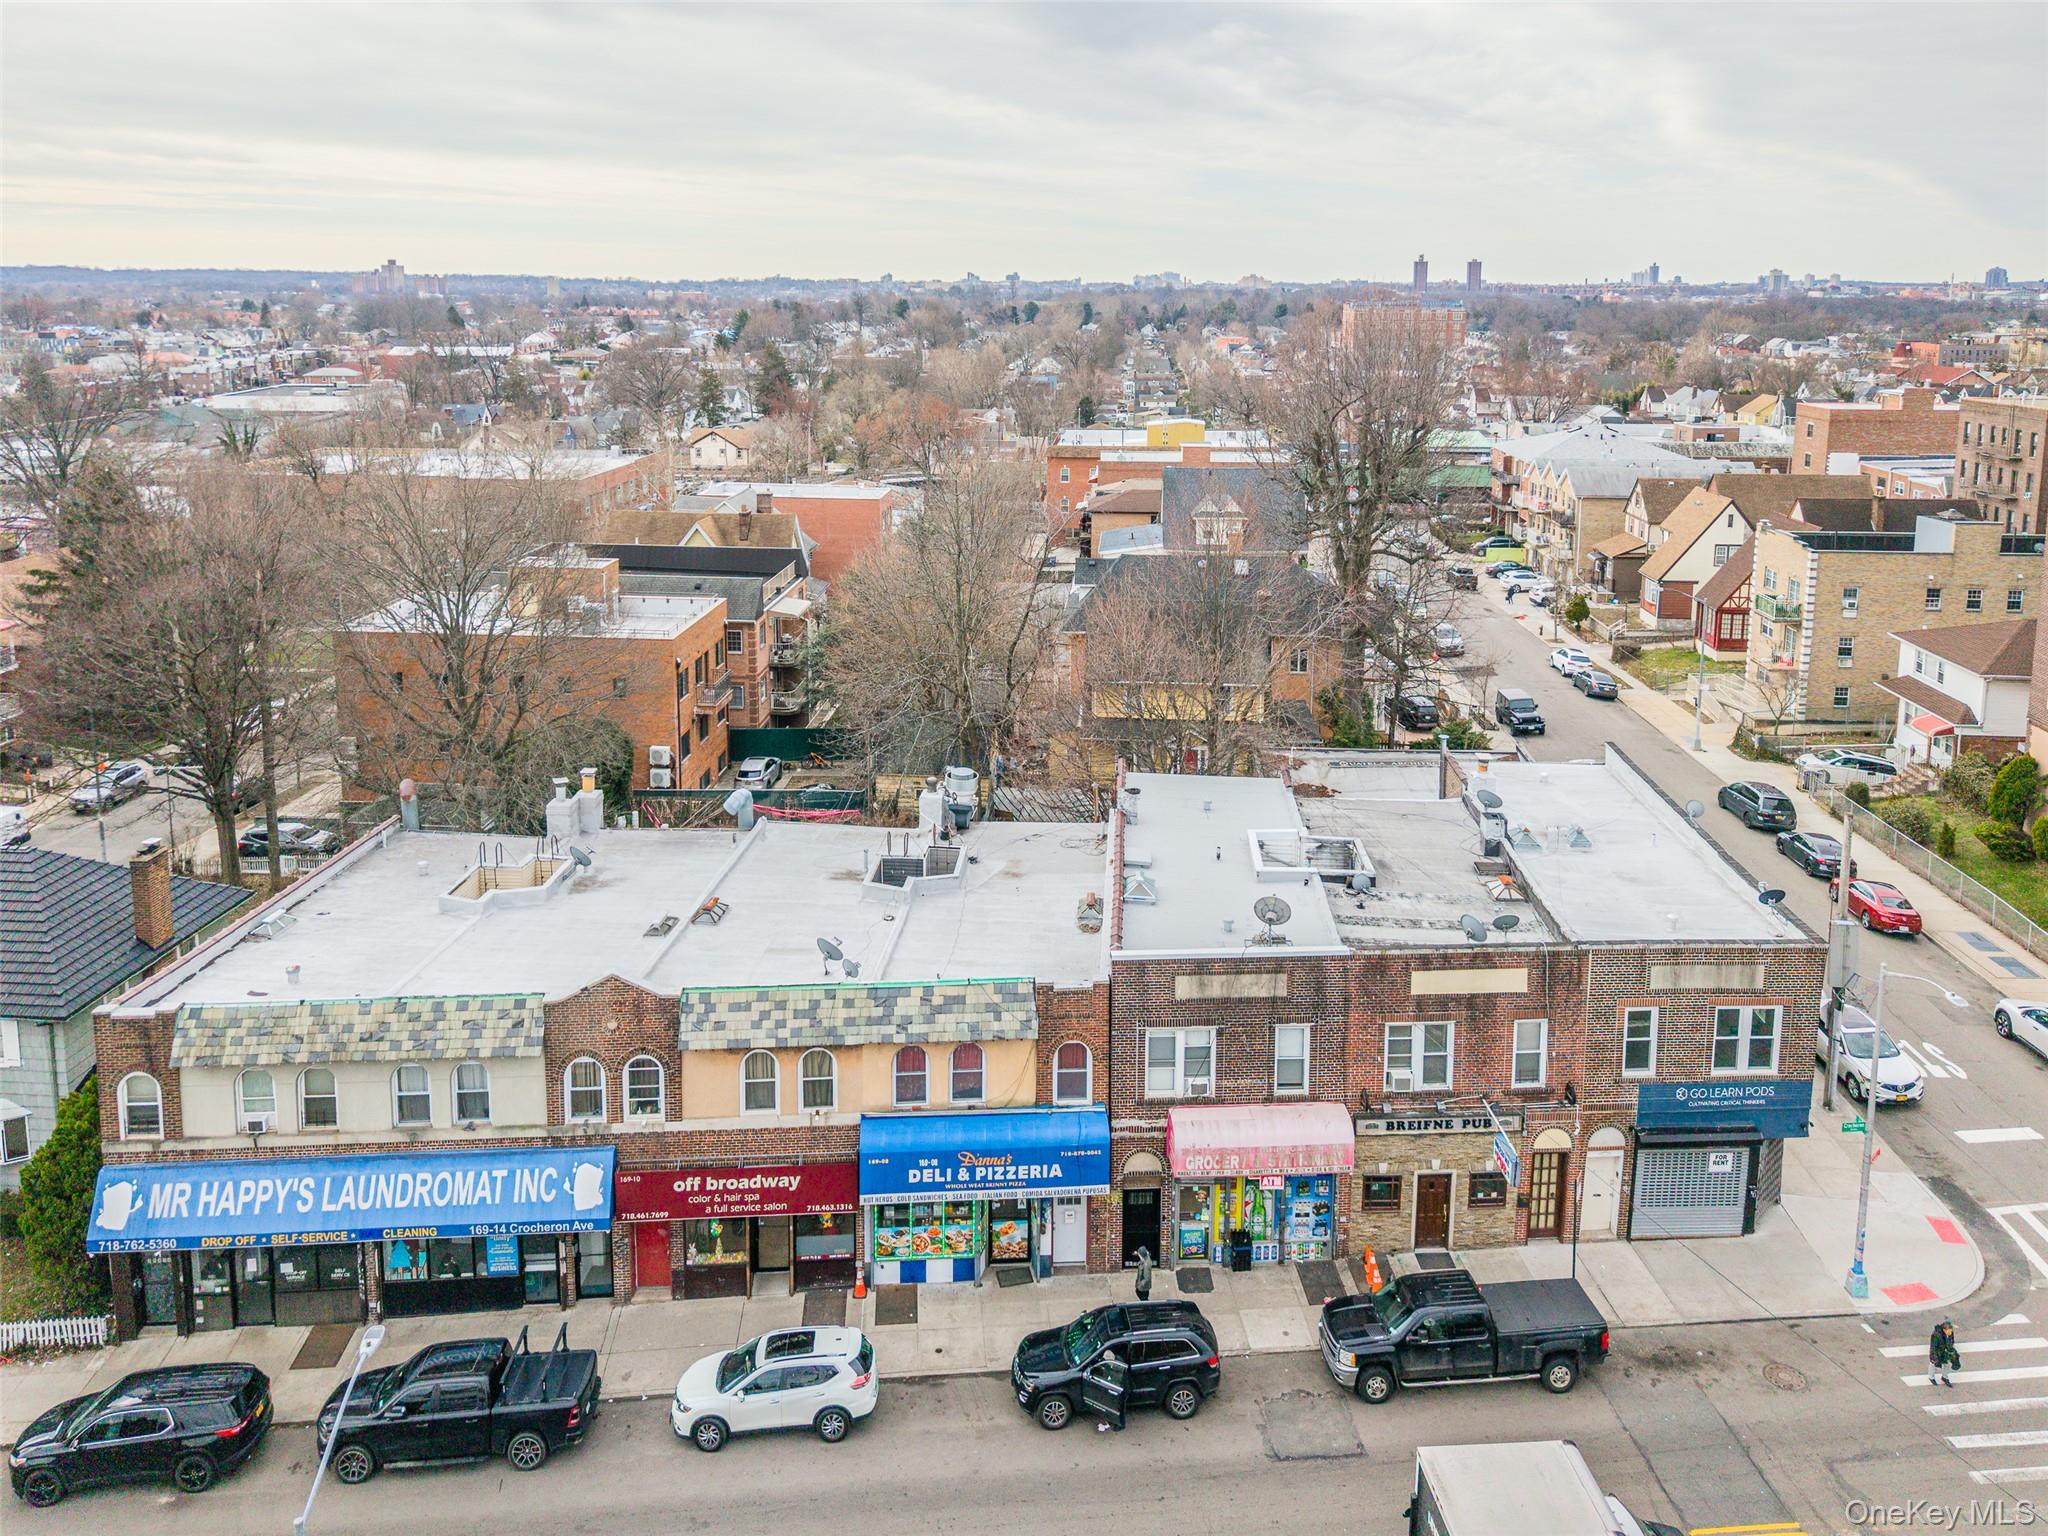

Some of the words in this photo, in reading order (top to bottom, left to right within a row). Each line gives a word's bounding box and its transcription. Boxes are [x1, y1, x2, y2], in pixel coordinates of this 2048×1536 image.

[1690, 1088, 1707, 1098] GO
[1709, 1087, 1743, 1098] LEARN
[1745, 1086, 1775, 1096] PODS
[1386, 1119, 1454, 1131] BREIFNE
[1462, 1118, 1492, 1129] PUB
[908, 1168, 952, 1183] DELI
[957, 1167, 970, 1181] &
[975, 1163, 1063, 1181] PIZZERIA
[673, 1177, 701, 1192] off
[706, 1174, 801, 1192] broadway
[1261, 1177, 1282, 1187] ATM
[147, 1183, 191, 1219] MR
[197, 1177, 315, 1217] HAPPY'S
[322, 1169, 508, 1212] LAUNDROMAT
[514, 1167, 557, 1203] INC
[688, 1195, 712, 1204] color
[714, 1194, 721, 1202] &
[723, 1193, 741, 1202] hair
[744, 1193, 760, 1203] spa
[912, 1194, 948, 1202] SANDWICHES
[712, 1204, 728, 1213] full
[730, 1204, 762, 1213] service
[764, 1202, 788, 1211] salon
[383, 1227, 437, 1239] CLEANING
[469, 1223, 506, 1235] 169-14
[509, 1221, 570, 1233] Crocheron
[572, 1220, 594, 1231] Ave
[99, 1239, 177, 1251] 718-762-5360
[202, 1237, 232, 1247] DROP
[235, 1236, 256, 1246] OFF
